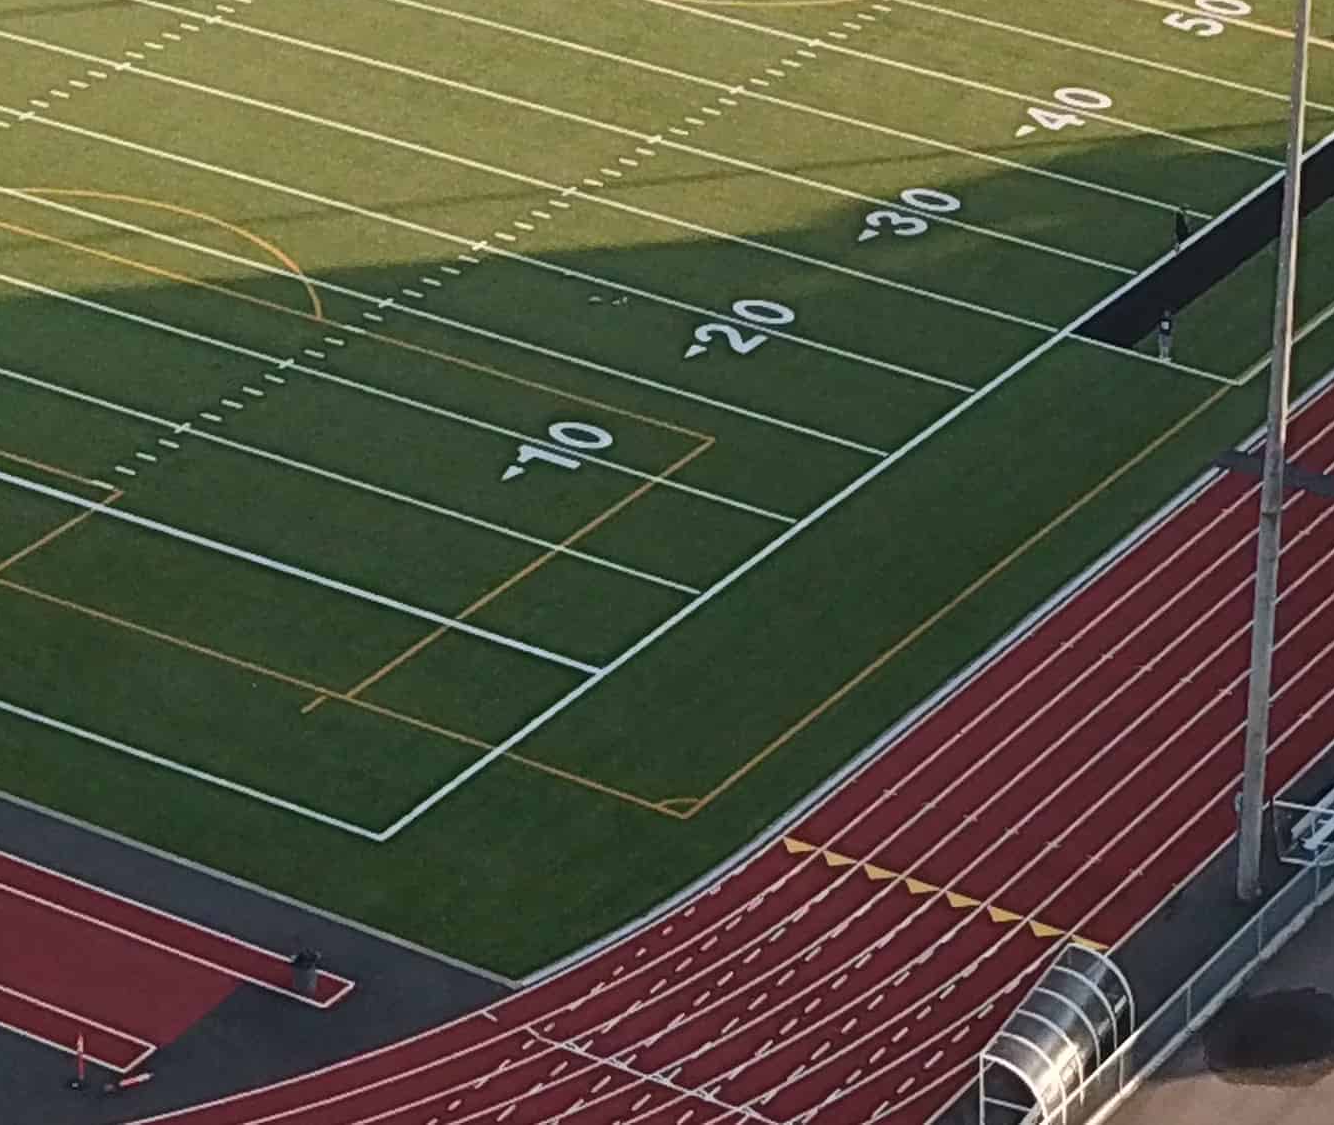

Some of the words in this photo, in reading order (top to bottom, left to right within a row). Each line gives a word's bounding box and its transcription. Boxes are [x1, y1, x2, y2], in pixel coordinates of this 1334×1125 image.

[1027, 87, 1112, 131] 40
[867, 188, 961, 237] 30
[695, 300, 795, 355] 20
[518, 422, 613, 469] 10
